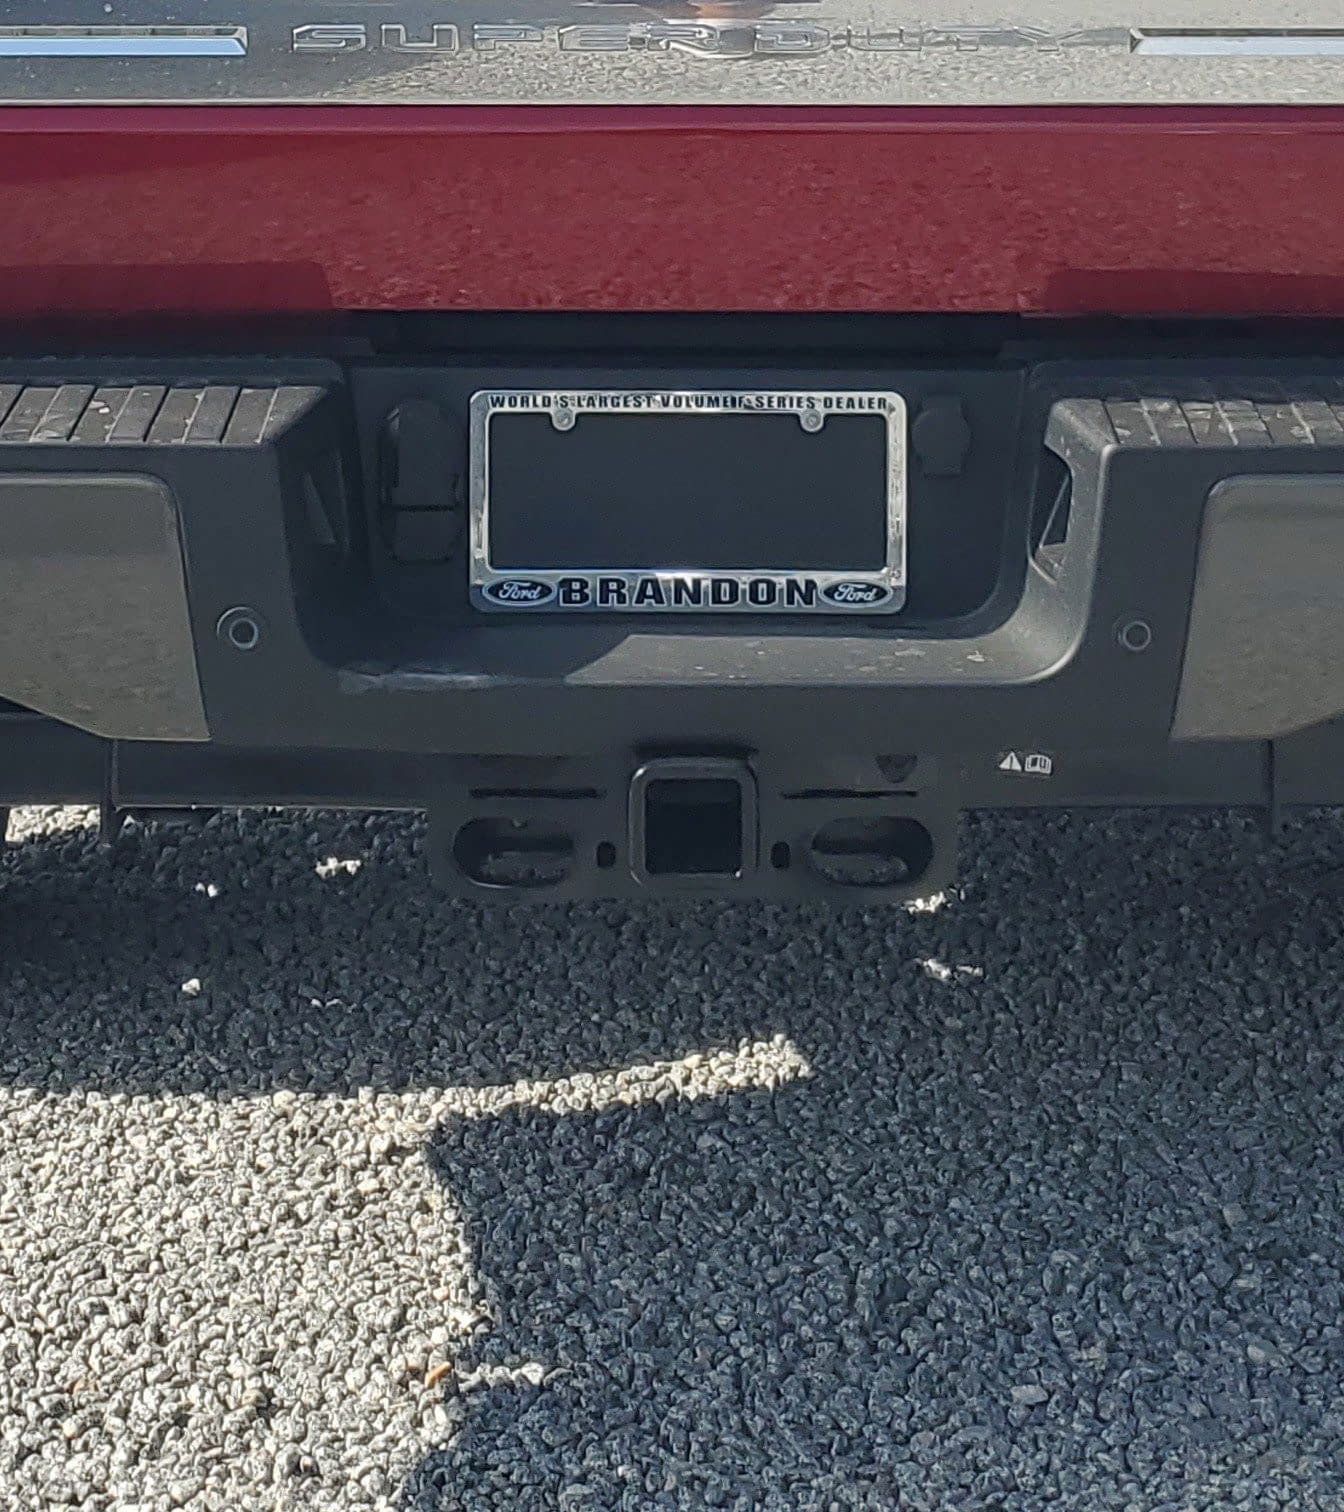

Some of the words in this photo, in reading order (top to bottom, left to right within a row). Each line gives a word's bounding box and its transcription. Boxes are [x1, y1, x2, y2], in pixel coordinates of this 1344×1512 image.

[291, 22, 726, 56] SUPER
[489, 394, 571, 409] WORLD'S
[576, 394, 654, 409] LARGEST
[822, 395, 888, 410] DEALER
[496, 581, 543, 601] Ford
[558, 575, 819, 608] BRANDON
[832, 582, 880, 602] Ford
